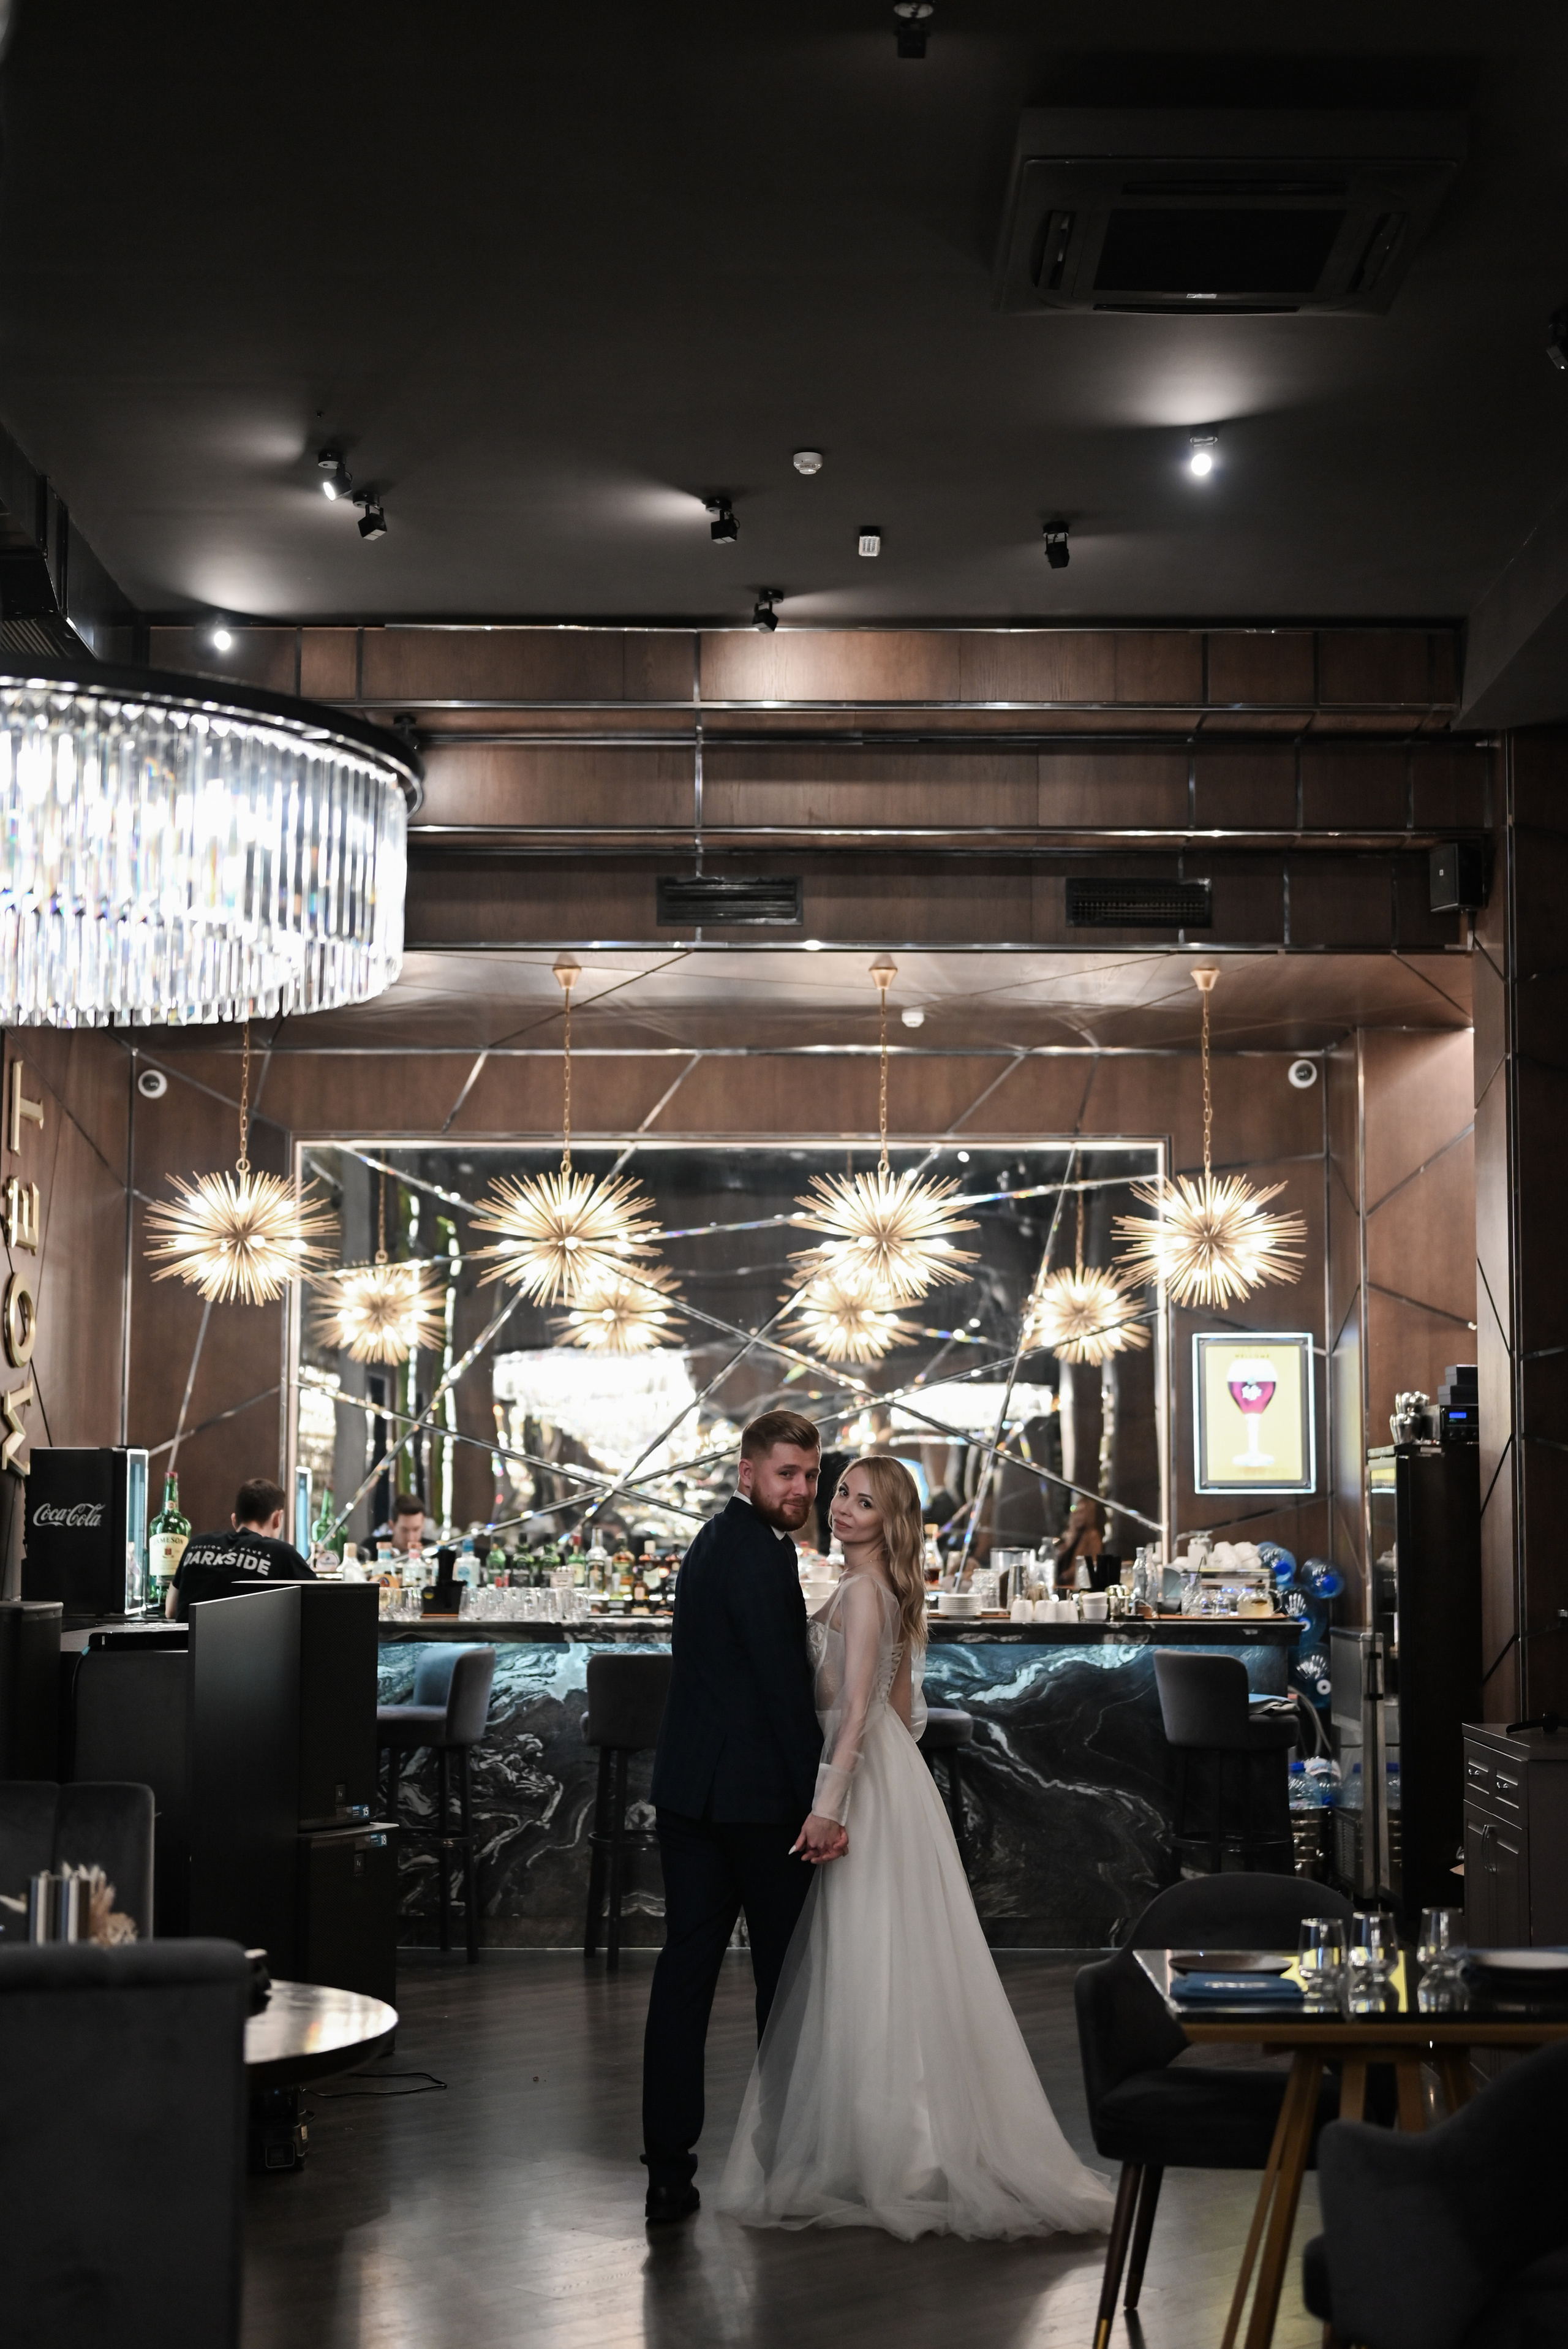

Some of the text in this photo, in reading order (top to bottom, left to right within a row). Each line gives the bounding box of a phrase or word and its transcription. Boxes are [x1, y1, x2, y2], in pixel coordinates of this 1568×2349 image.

[33, 1503, 105, 1526] Coca-Cola
[153, 1536, 183, 1545] JAMESON
[240, 1547, 262, 1556] HAVE
[183, 1550, 271, 1576] DARKSIDE
[363, 1807, 369, 1817] 15
[380, 1834, 386, 1845] 18
